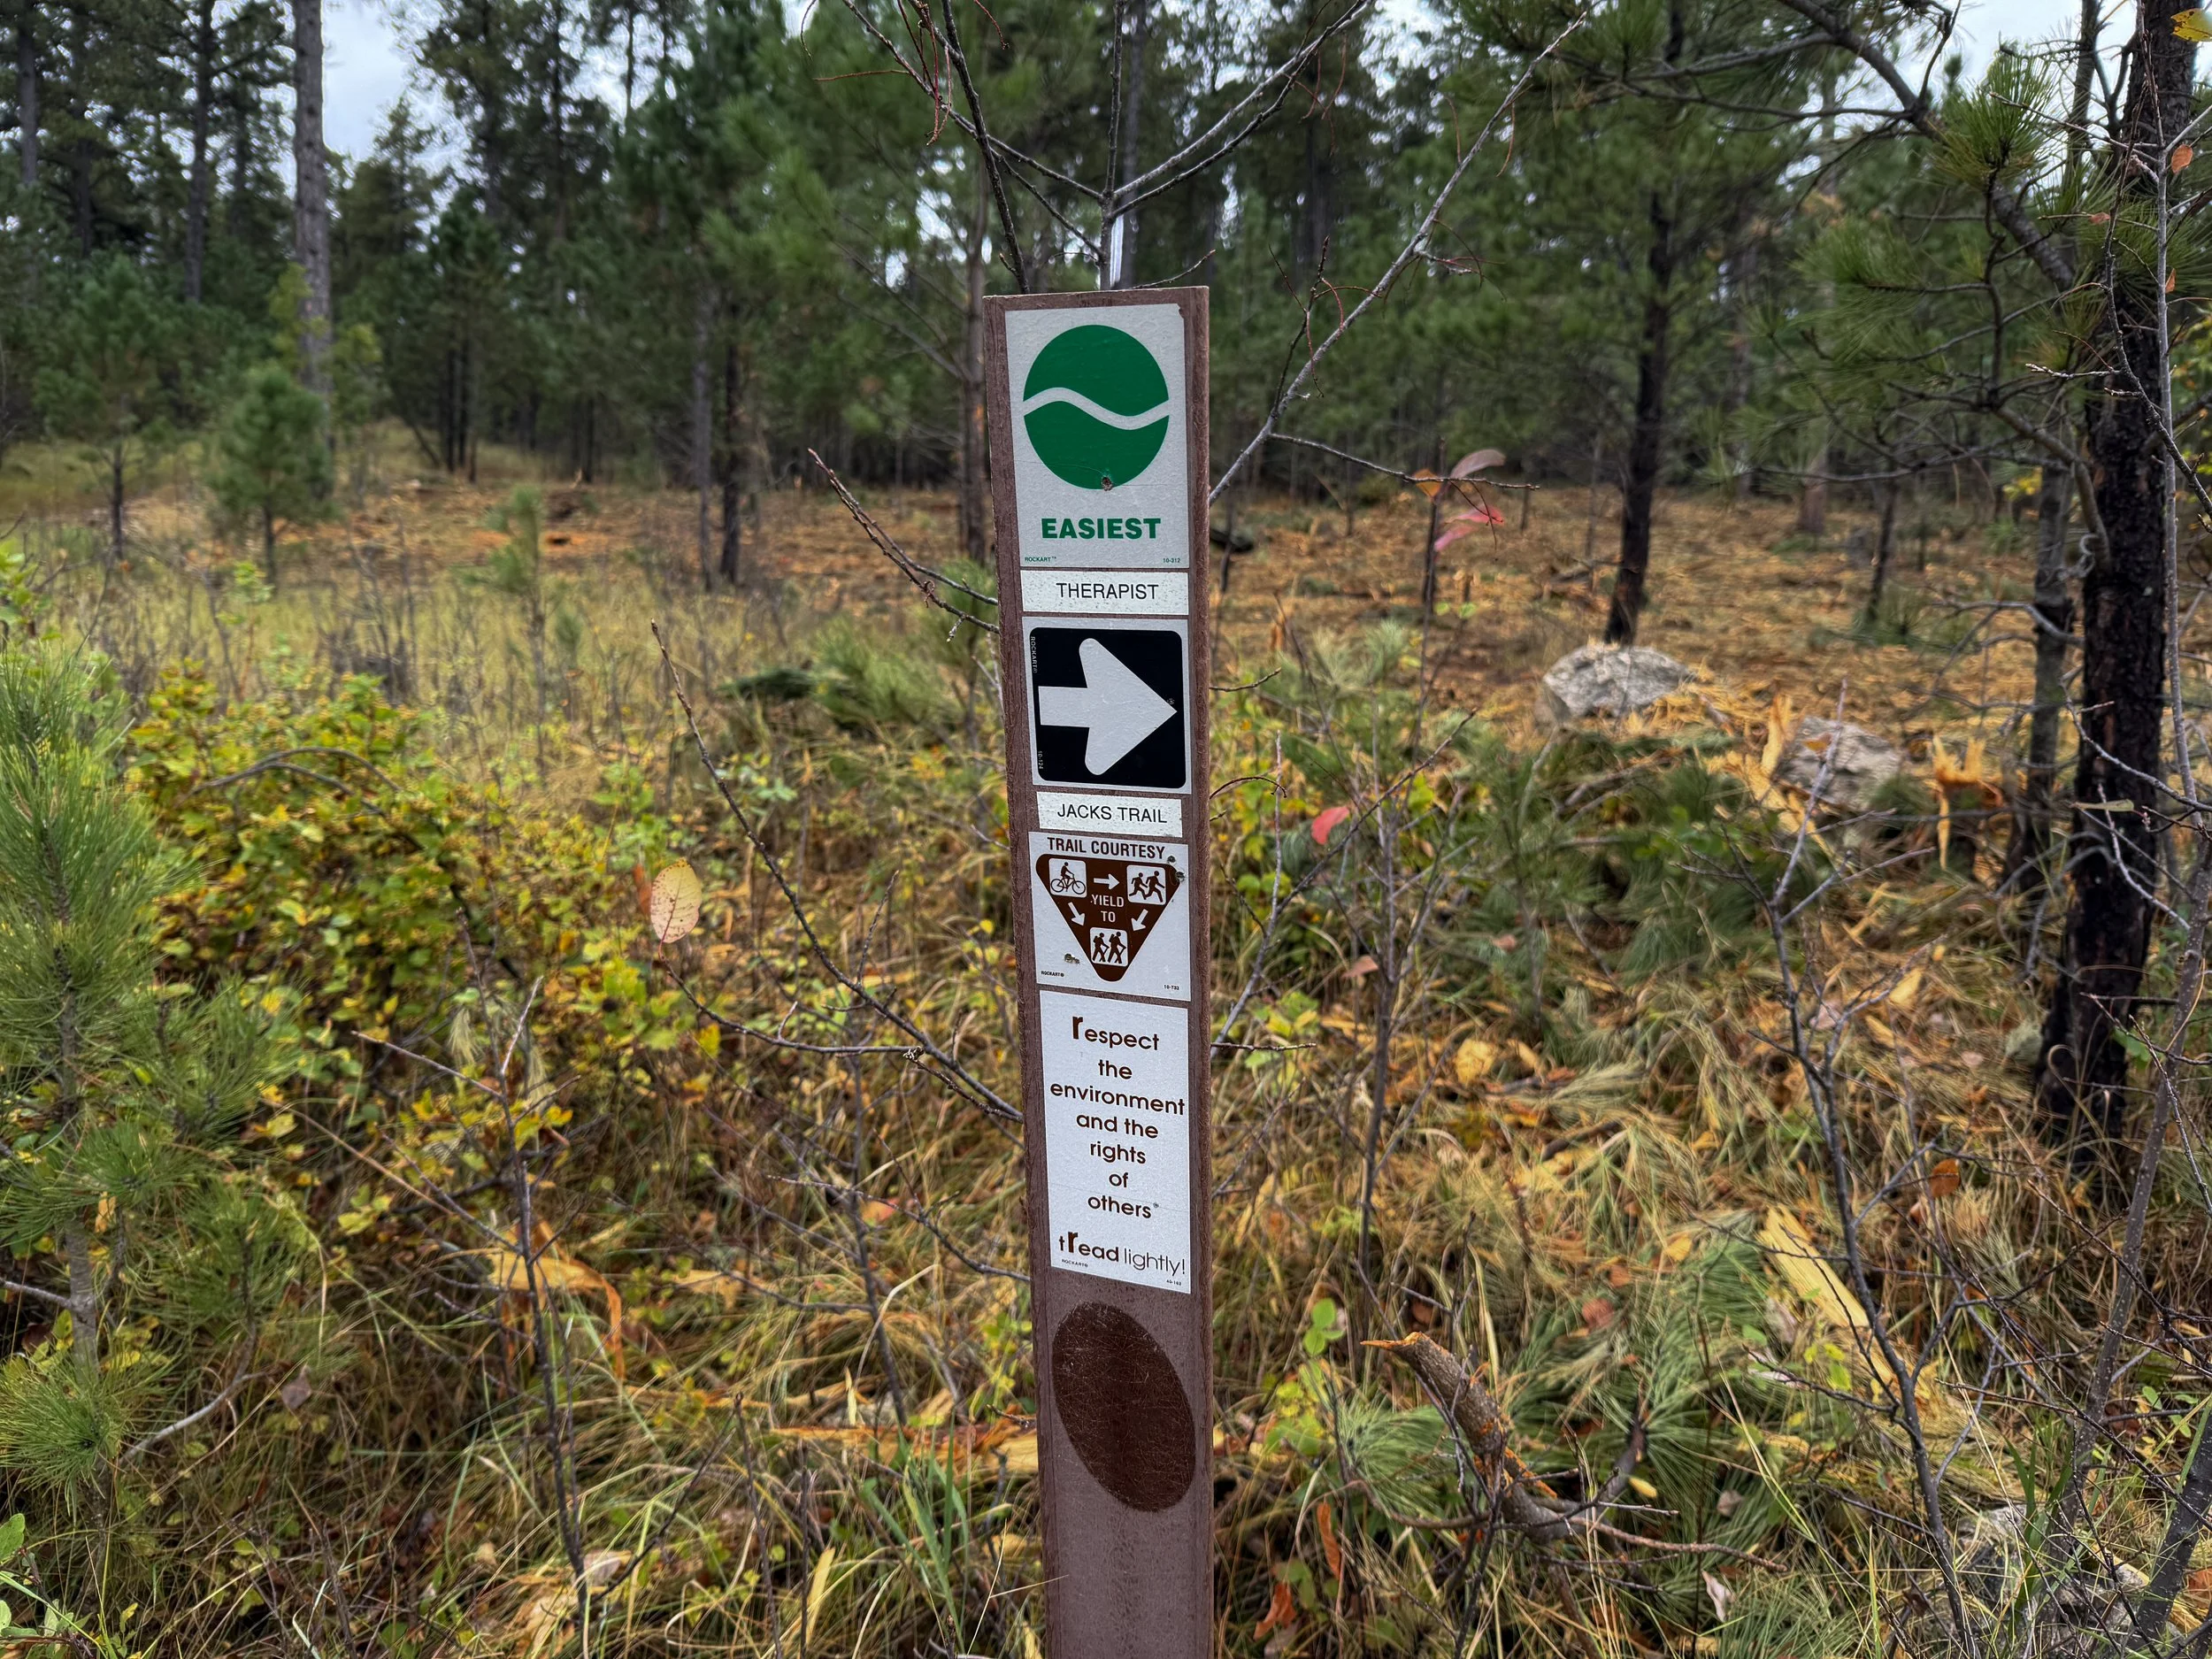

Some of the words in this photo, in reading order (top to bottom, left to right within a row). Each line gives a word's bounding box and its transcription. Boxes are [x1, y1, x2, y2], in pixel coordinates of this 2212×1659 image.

[1041, 518, 1161, 539] EASIEST
[1056, 582, 1158, 599] THERAPIST
[1057, 803, 1112, 820] JACKS
[1118, 807, 1167, 823] TRAIL
[1047, 837, 1087, 853] TRAIL
[1091, 841, 1164, 859] COURTESY
[1092, 895, 1125, 908] YIELD
[1101, 910, 1116, 923] TO
[1072, 1016, 1159, 1050] respect
[1098, 1059, 1133, 1079] the
[1050, 1083, 1185, 1116] environment
[1076, 1114, 1118, 1133] and
[1124, 1118, 1158, 1139] the
[1090, 1141, 1147, 1164] rights
[1109, 1172, 1129, 1187] of
[1058, 1231, 1119, 1263] tread
[1124, 1248, 1186, 1277] lightly!
